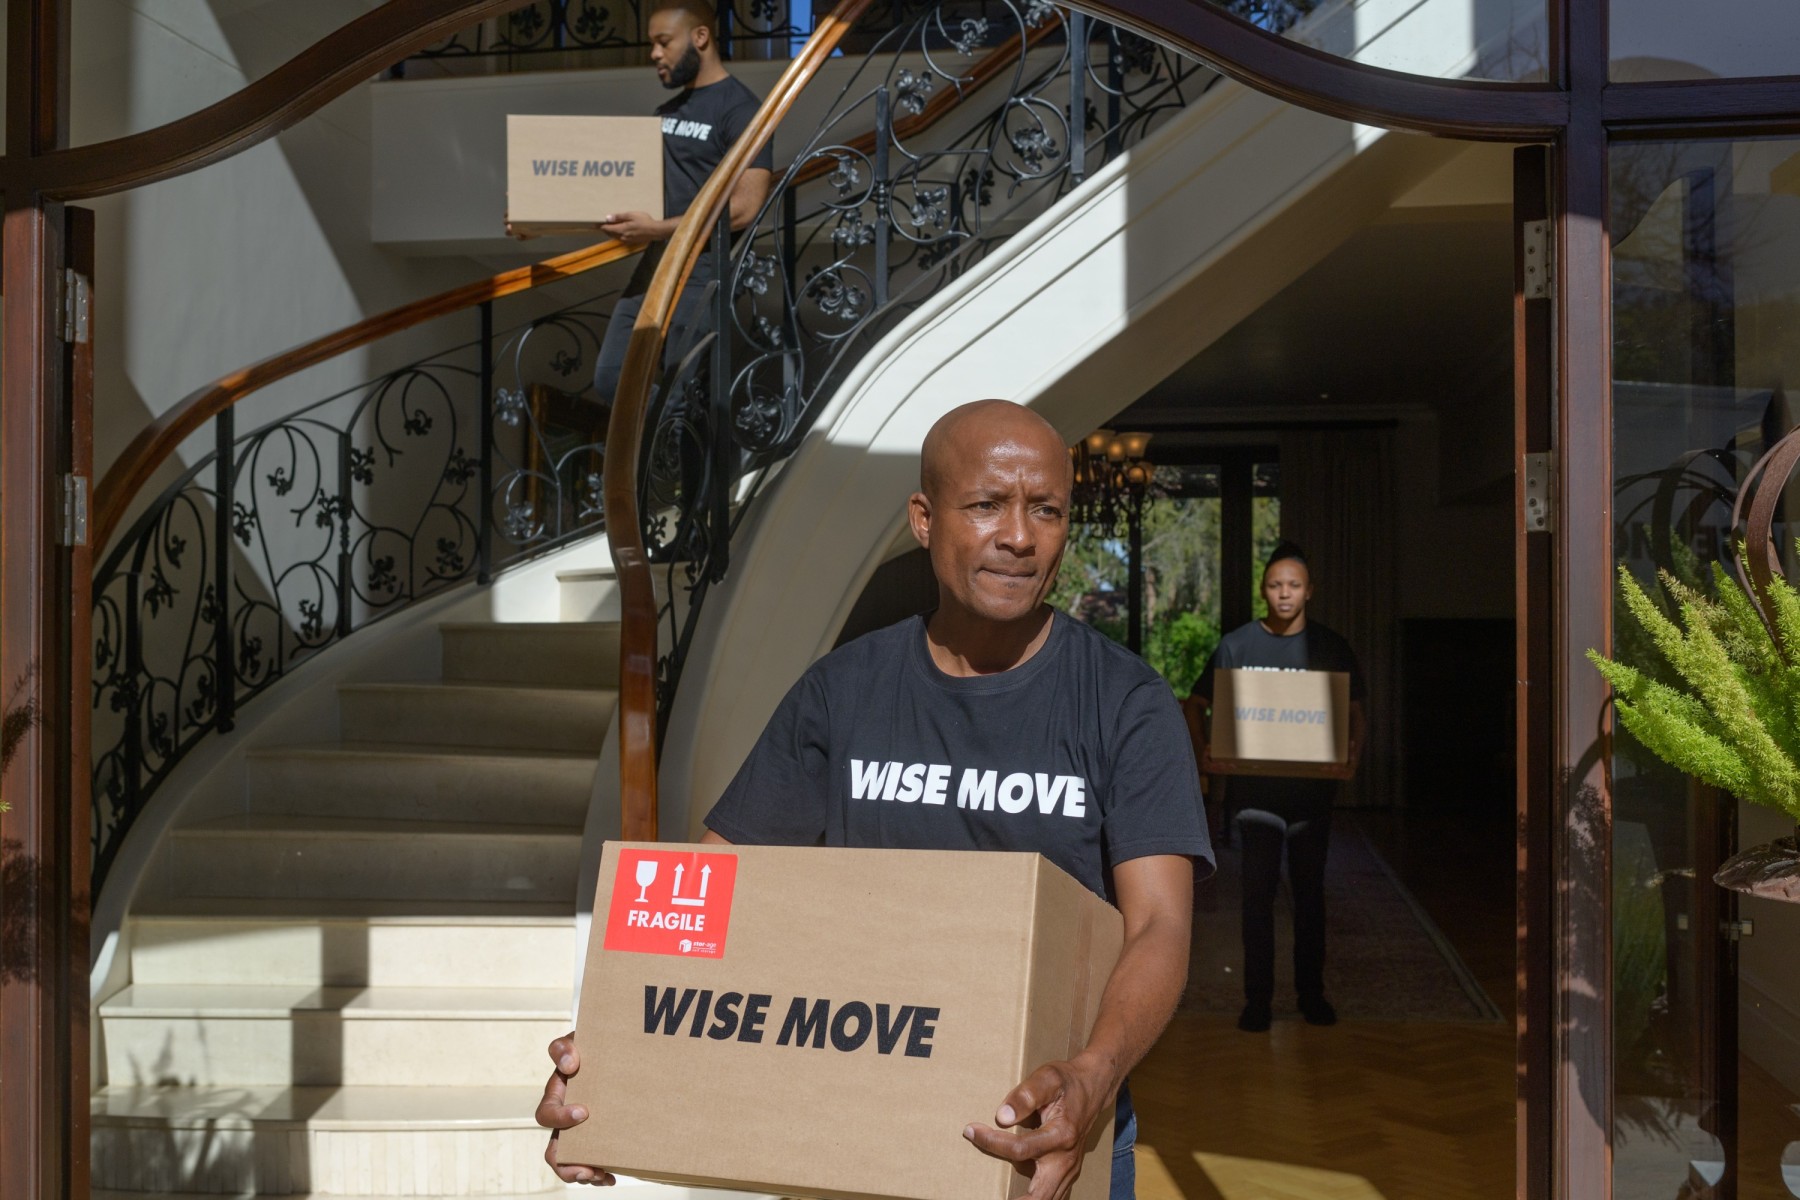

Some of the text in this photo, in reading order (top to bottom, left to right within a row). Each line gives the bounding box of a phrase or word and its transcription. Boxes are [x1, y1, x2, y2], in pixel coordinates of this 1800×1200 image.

[674, 119, 712, 141] MOVE
[532, 160, 635, 177] WISE MOVE
[1235, 707, 1327, 725] WISE MOVE
[851, 759, 1086, 818] WISE MOVE
[627, 909, 705, 932] FRAGILE
[644, 985, 941, 1059] WISE MOVE
